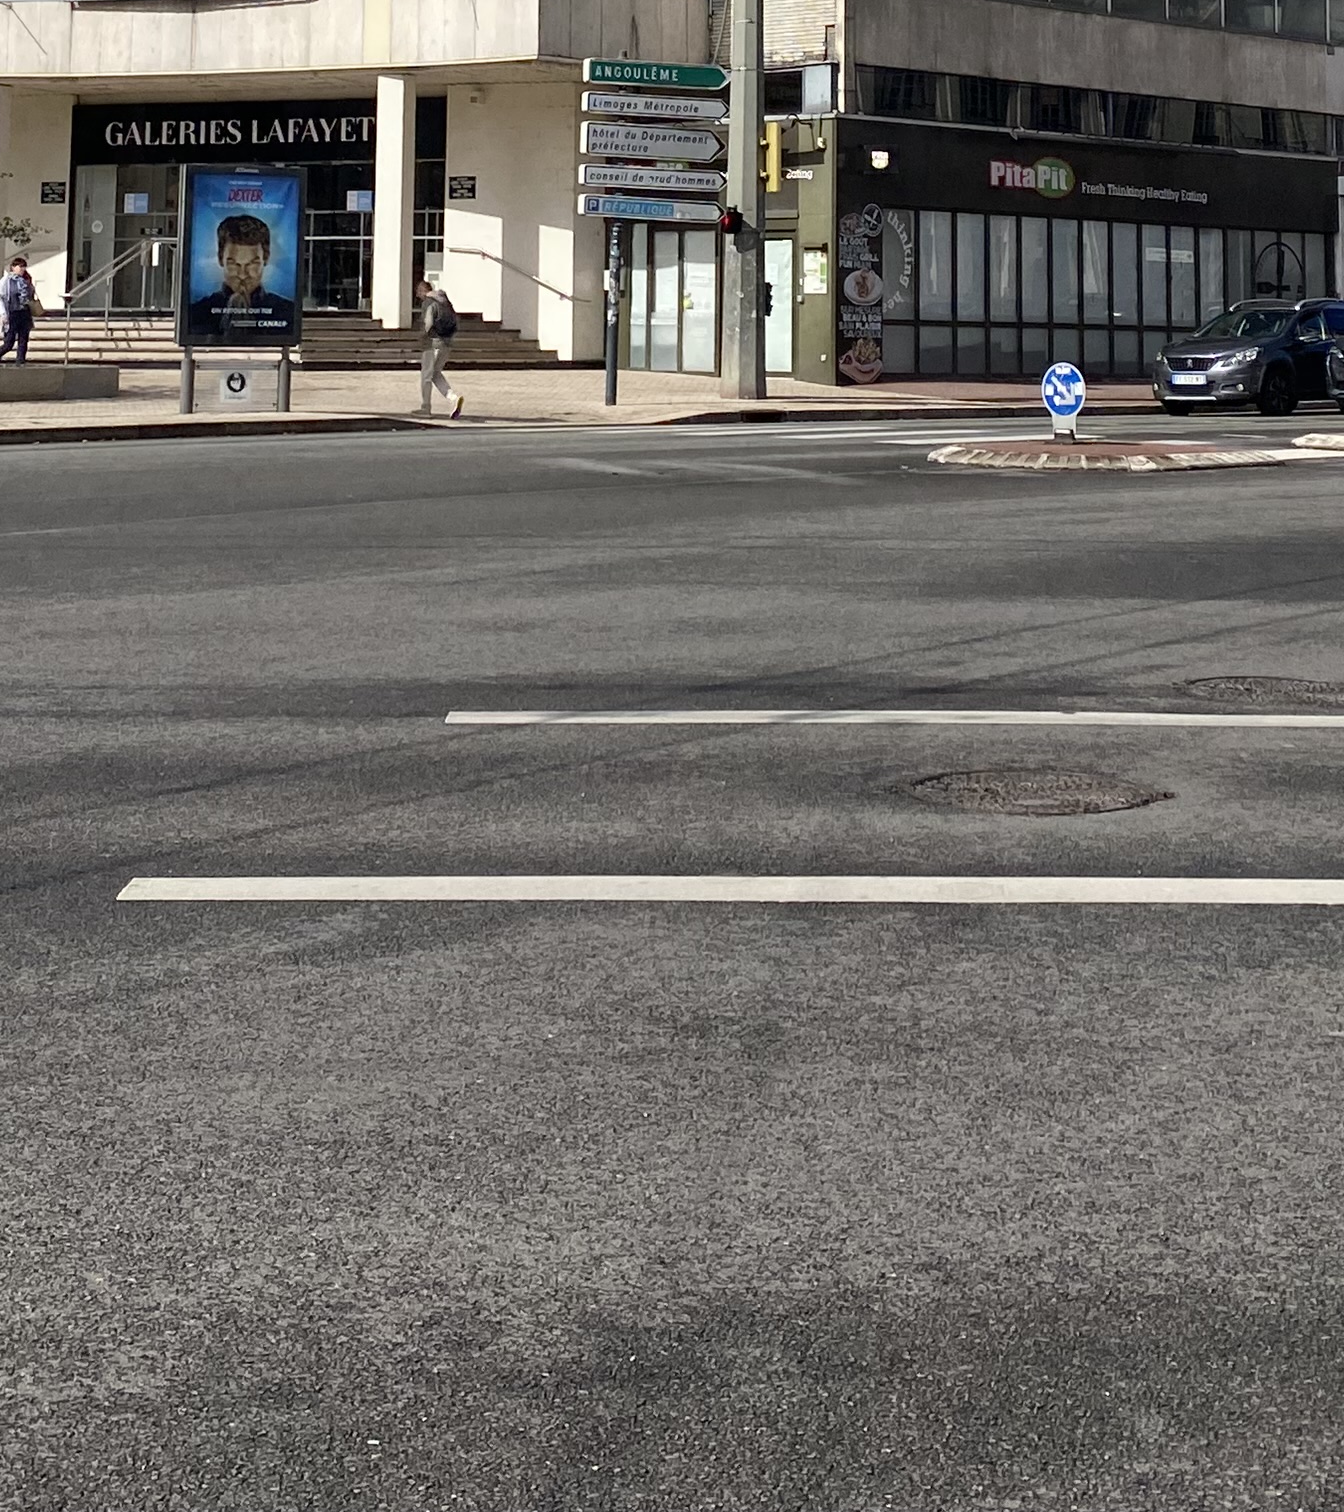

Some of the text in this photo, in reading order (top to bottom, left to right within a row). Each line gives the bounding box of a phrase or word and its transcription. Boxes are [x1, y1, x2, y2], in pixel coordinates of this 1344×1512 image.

[595, 65, 679, 81] ANGOULÊME
[593, 98, 699, 114] Limoges Métropole
[105, 116, 375, 146] GALERIES LAFAYET
[592, 128, 709, 145] hôtel du Département
[591, 141, 649, 153] préfecture
[589, 172, 628, 182] conseil
[632, 173, 644, 182] de
[1081, 181, 1106, 195] Fresh
[1107, 183, 1146, 200] Thinking
[1147, 186, 1180, 202] Healthy
[603, 200, 673, 217] RÉPUBLIQUE
